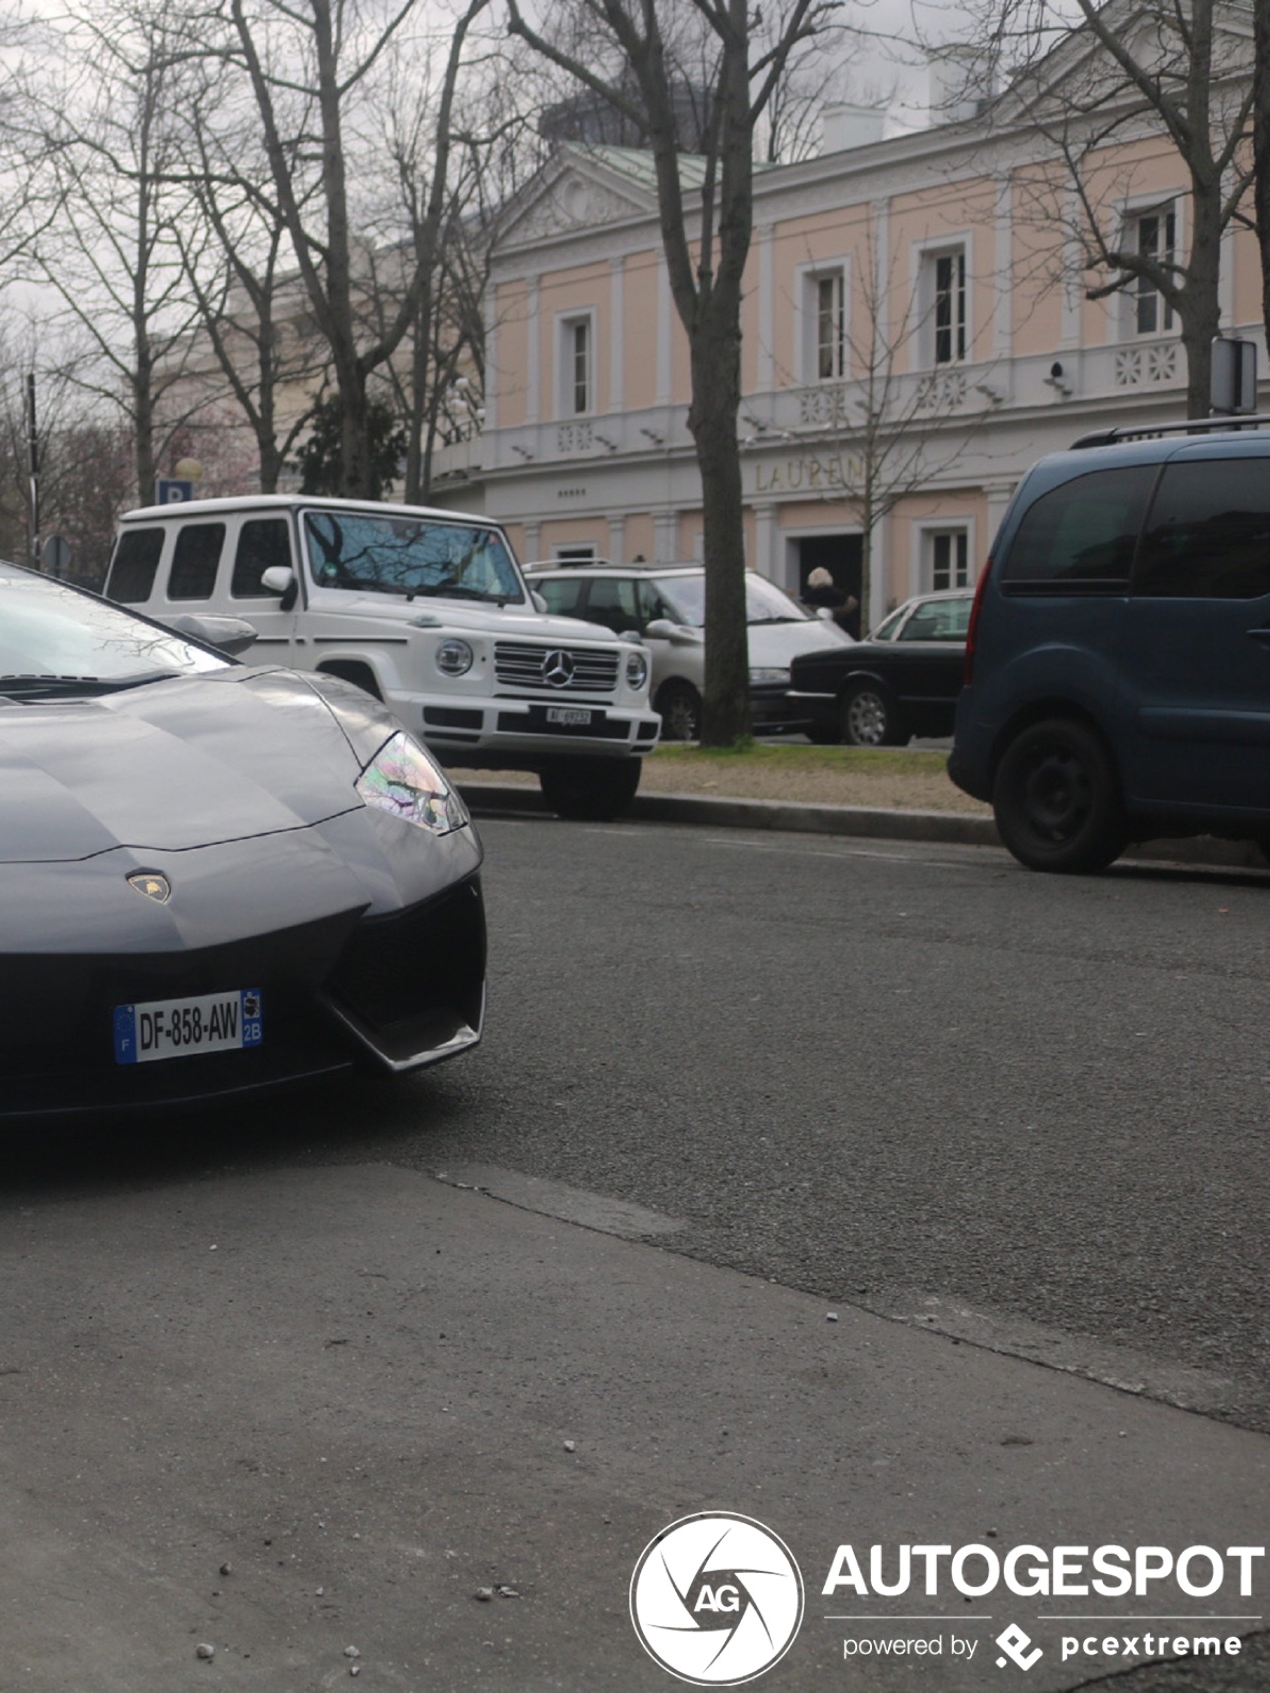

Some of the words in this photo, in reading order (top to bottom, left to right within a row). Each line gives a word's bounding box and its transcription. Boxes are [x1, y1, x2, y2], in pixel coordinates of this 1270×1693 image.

[140, 1001, 238, 1050] DF-858-AW
[244, 1023, 261, 1042] 2B
[121, 1039, 130, 1051] F
